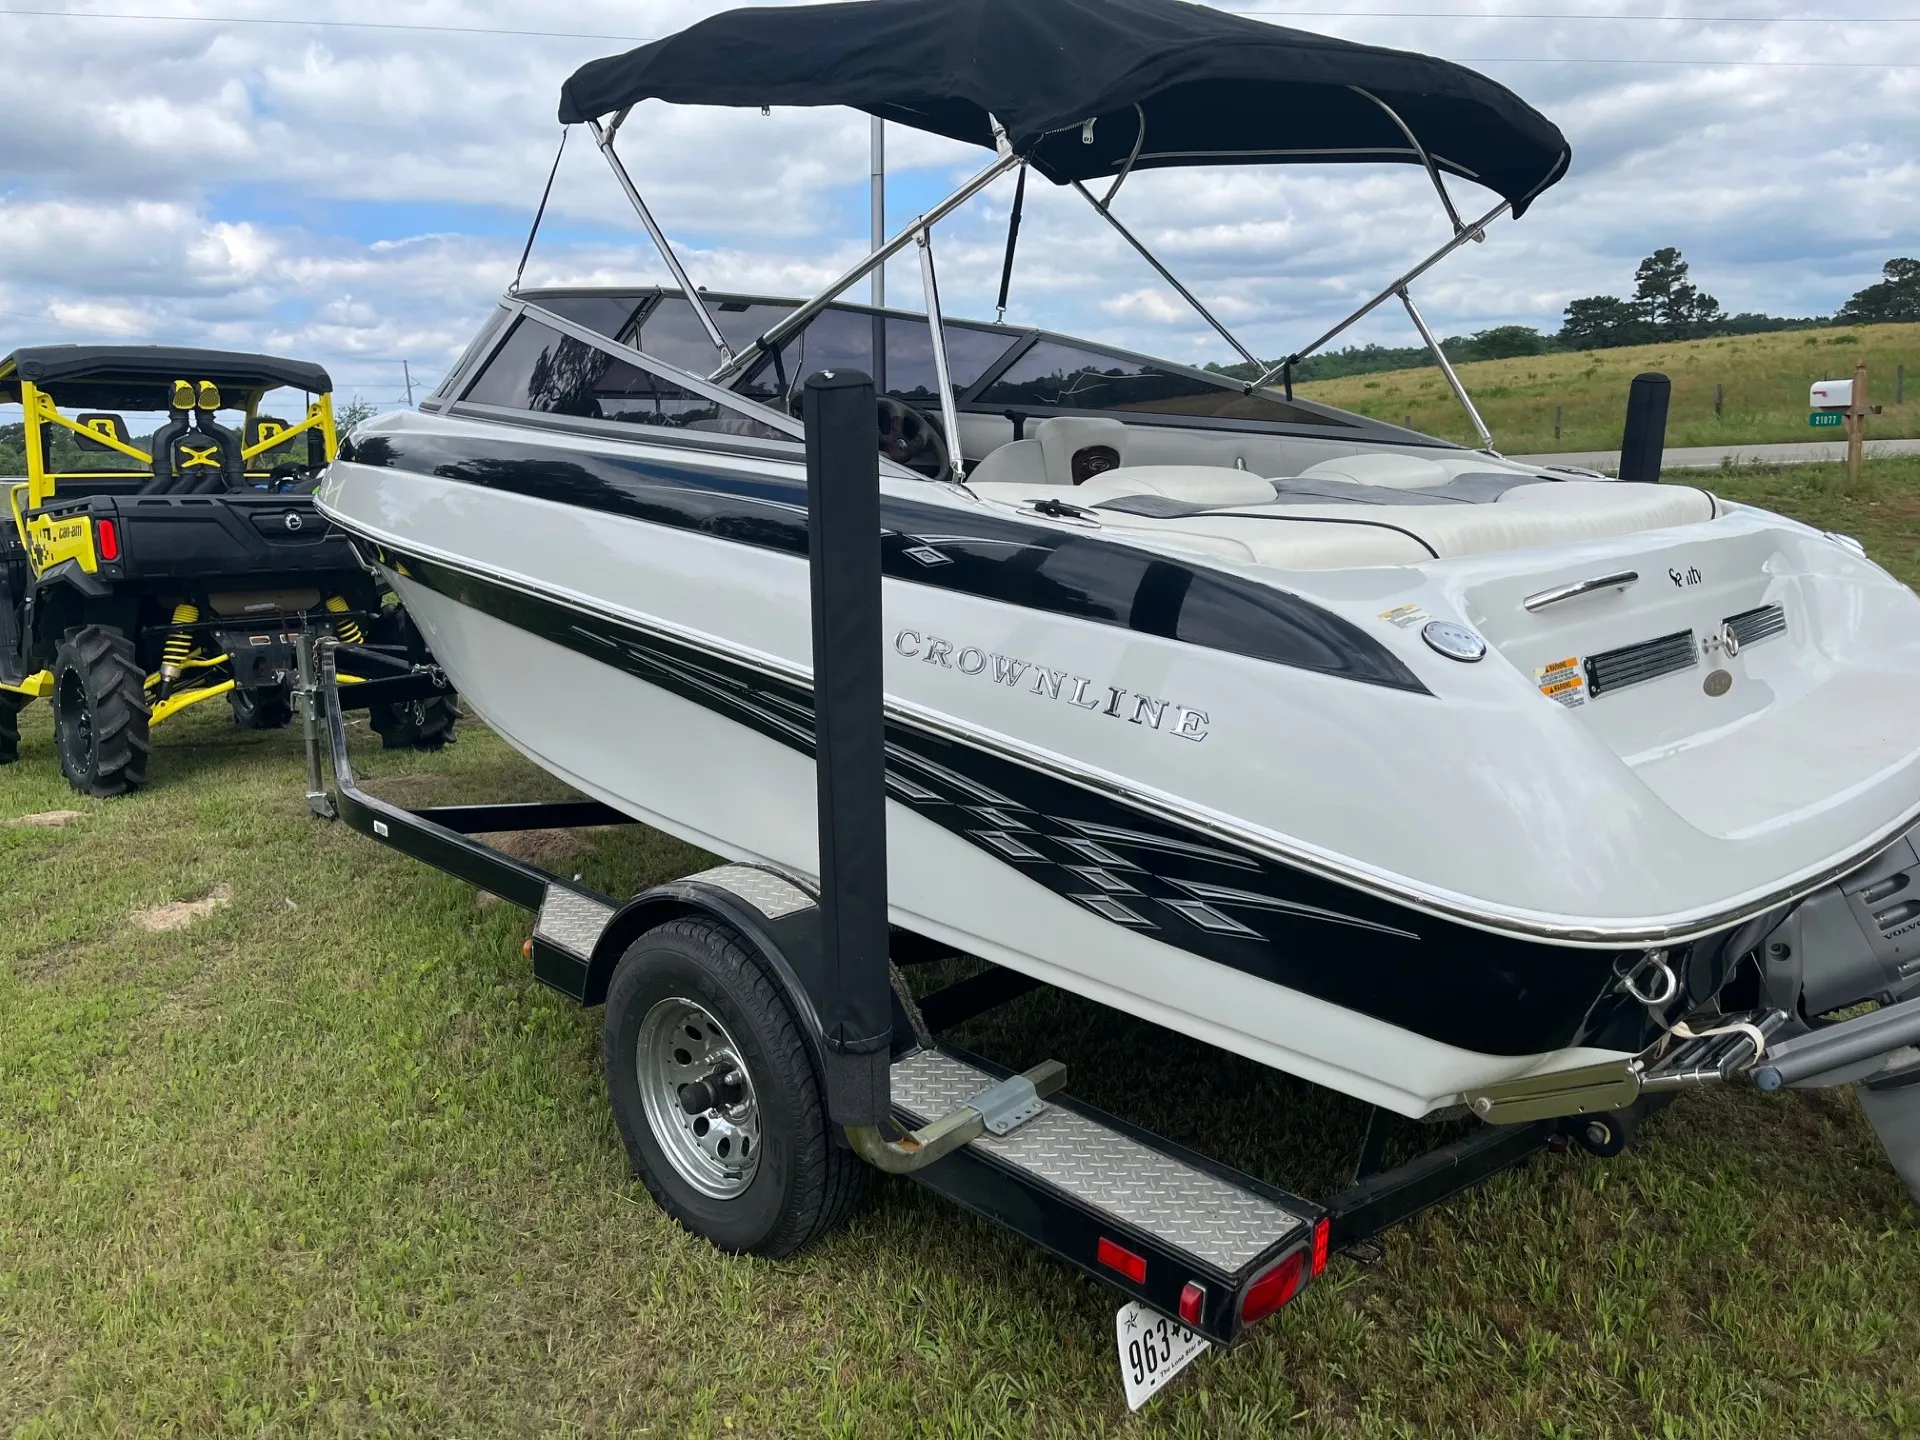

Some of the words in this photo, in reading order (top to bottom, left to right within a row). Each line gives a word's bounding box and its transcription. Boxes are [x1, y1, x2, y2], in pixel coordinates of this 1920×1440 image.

[1815, 415, 1837, 425] 21077
[59, 525, 82, 540] can-am
[893, 629, 1210, 742] CROWNLINE
[1171, 1355, 1184, 1368] Lone
[1185, 1344, 1196, 1356] Star
